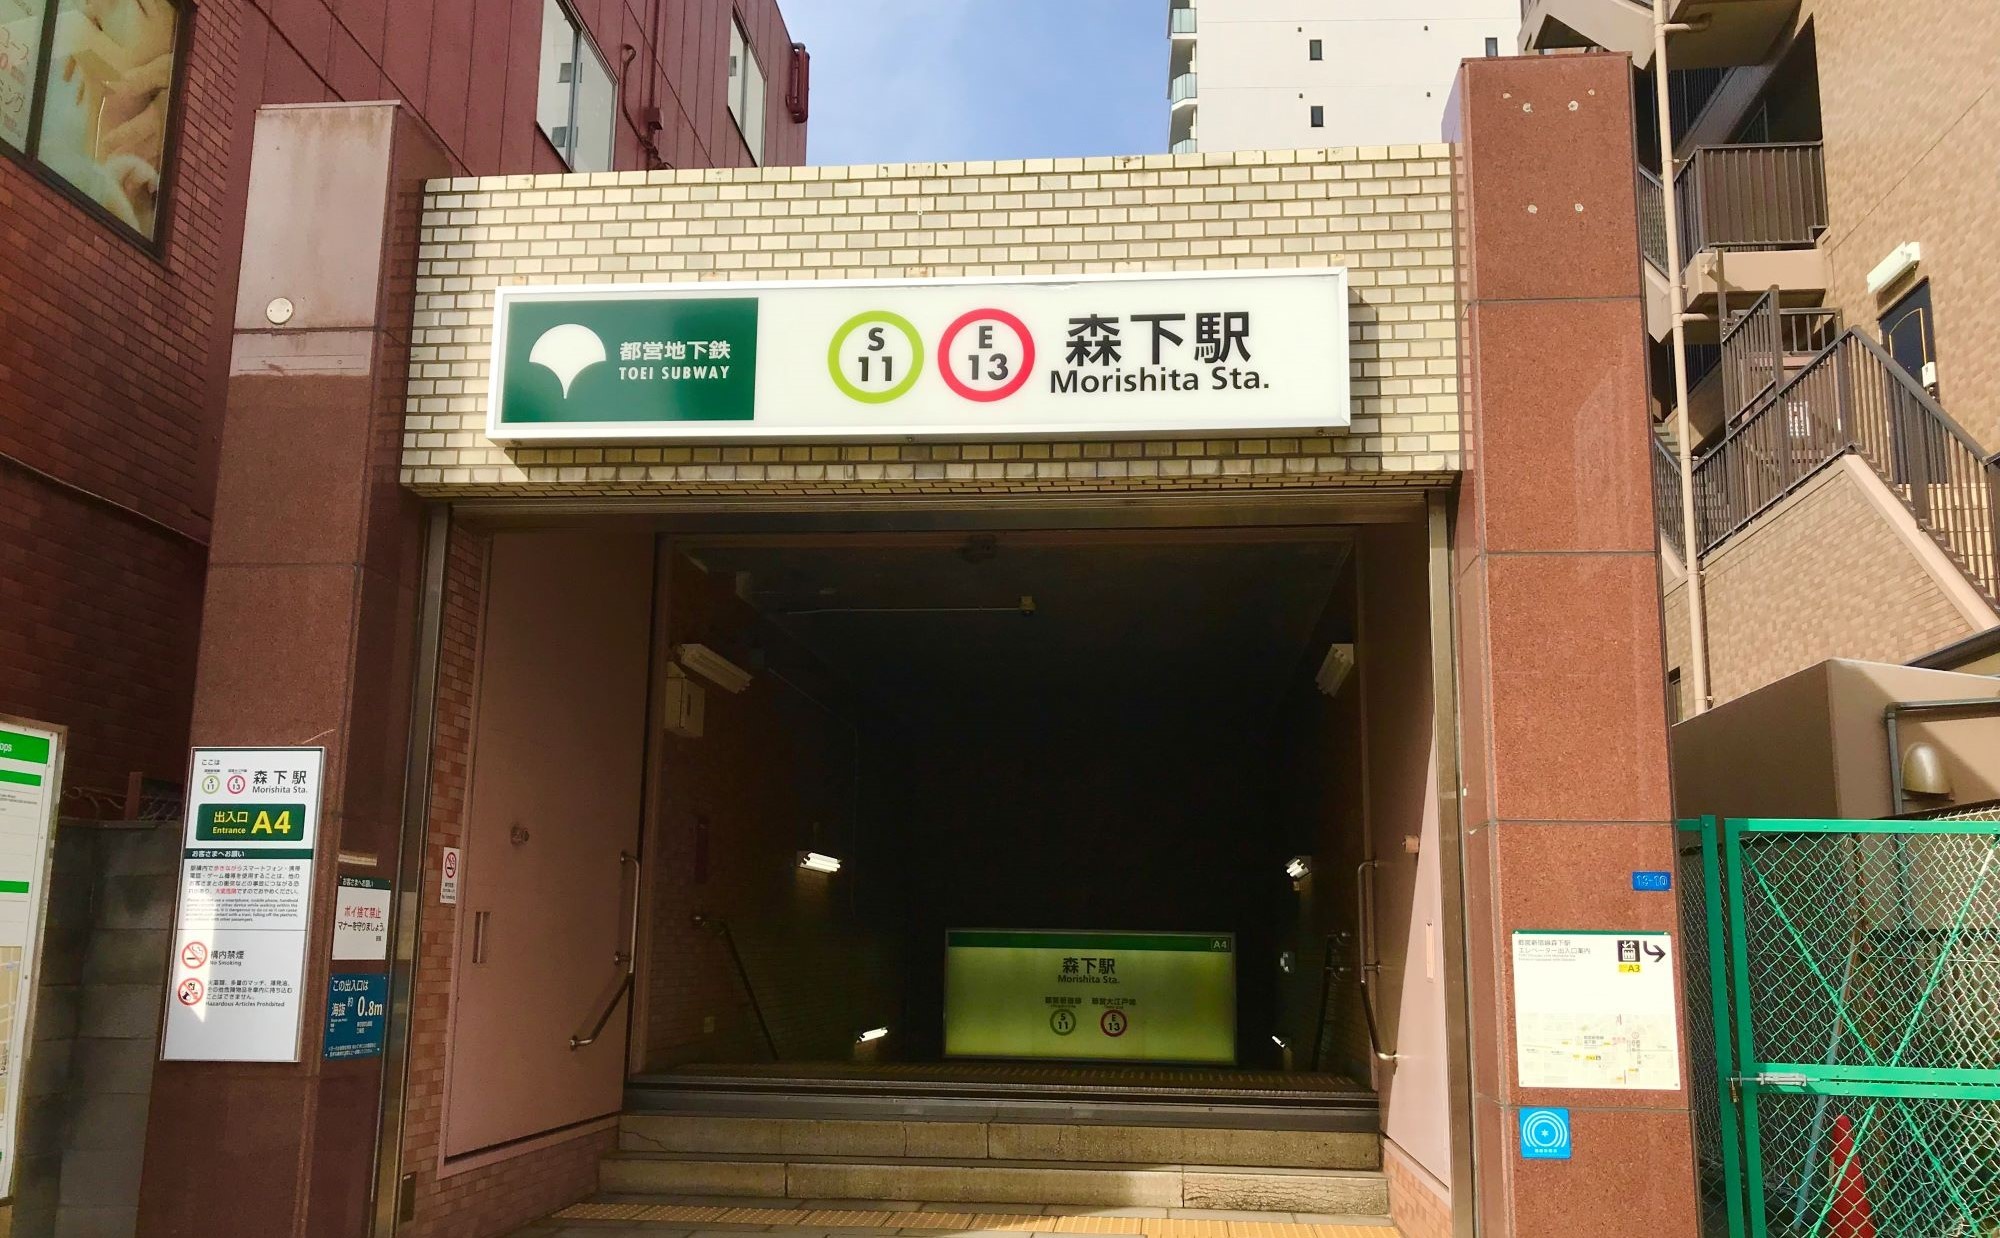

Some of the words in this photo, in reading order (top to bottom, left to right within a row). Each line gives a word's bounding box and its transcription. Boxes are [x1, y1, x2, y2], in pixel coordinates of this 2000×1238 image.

[867, 327, 885, 351] S
[978, 325, 993, 349] E
[1065, 312, 1251, 367] 森下駅
[619, 340, 731, 361] 都営地下鉄
[619, 366, 654, 380] TOEI
[661, 365, 730, 380] SUBWAY
[858, 356, 893, 382] 11
[968, 353, 1009, 381] 13
[1050, 366, 1199, 393] Morishita
[1211, 366, 1270, 391] Sta.
[253, 770, 307, 785] 森下駅
[252, 785, 291, 794] Morishita
[293, 785, 308, 794] Sta.
[213, 811, 248, 823] 出入口
[251, 810, 291, 834] A4
[212, 826, 246, 834] Entrance
[191, 850, 245, 858] お客さまへお願い
[344, 905, 381, 919] ポイ捨て禁止
[1213, 940, 1226, 949] A4
[211, 950, 245, 960] 構内禁煙
[1062, 957, 1115, 975] 森下駅
[333, 979, 369, 992] この出入口は
[1057, 974, 1100, 984] Morishita
[1102, 975, 1120, 984] Sta.
[331, 1002, 346, 1017] 海抜
[357, 995, 383, 1017] 0.8m
[1060, 1013, 1066, 1021] S
[1111, 1014, 1117, 1022] E
[1058, 1021, 1069, 1030] 11
[1108, 1022, 1121, 1031] 13
